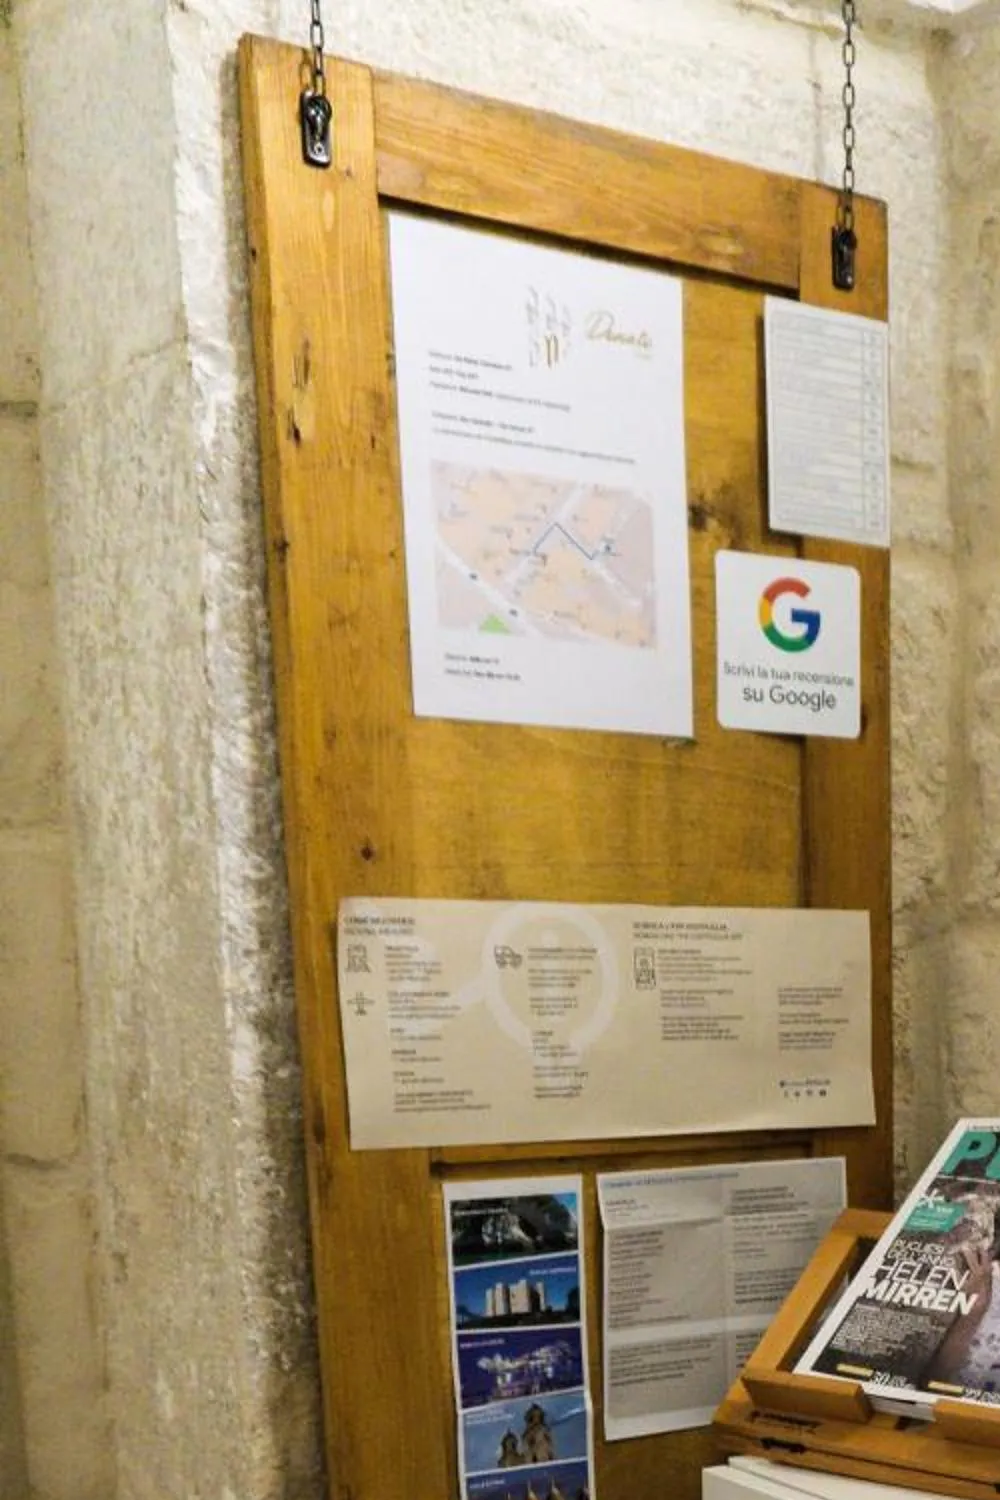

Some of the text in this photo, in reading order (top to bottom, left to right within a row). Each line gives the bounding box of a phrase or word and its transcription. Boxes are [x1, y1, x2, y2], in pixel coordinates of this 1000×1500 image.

[724, 661, 855, 687] Scrivi la tua recensione
[743, 684, 837, 713] su Google
[871, 1259, 971, 1291] HELEN
[862, 1277, 980, 1315] MIRREN
